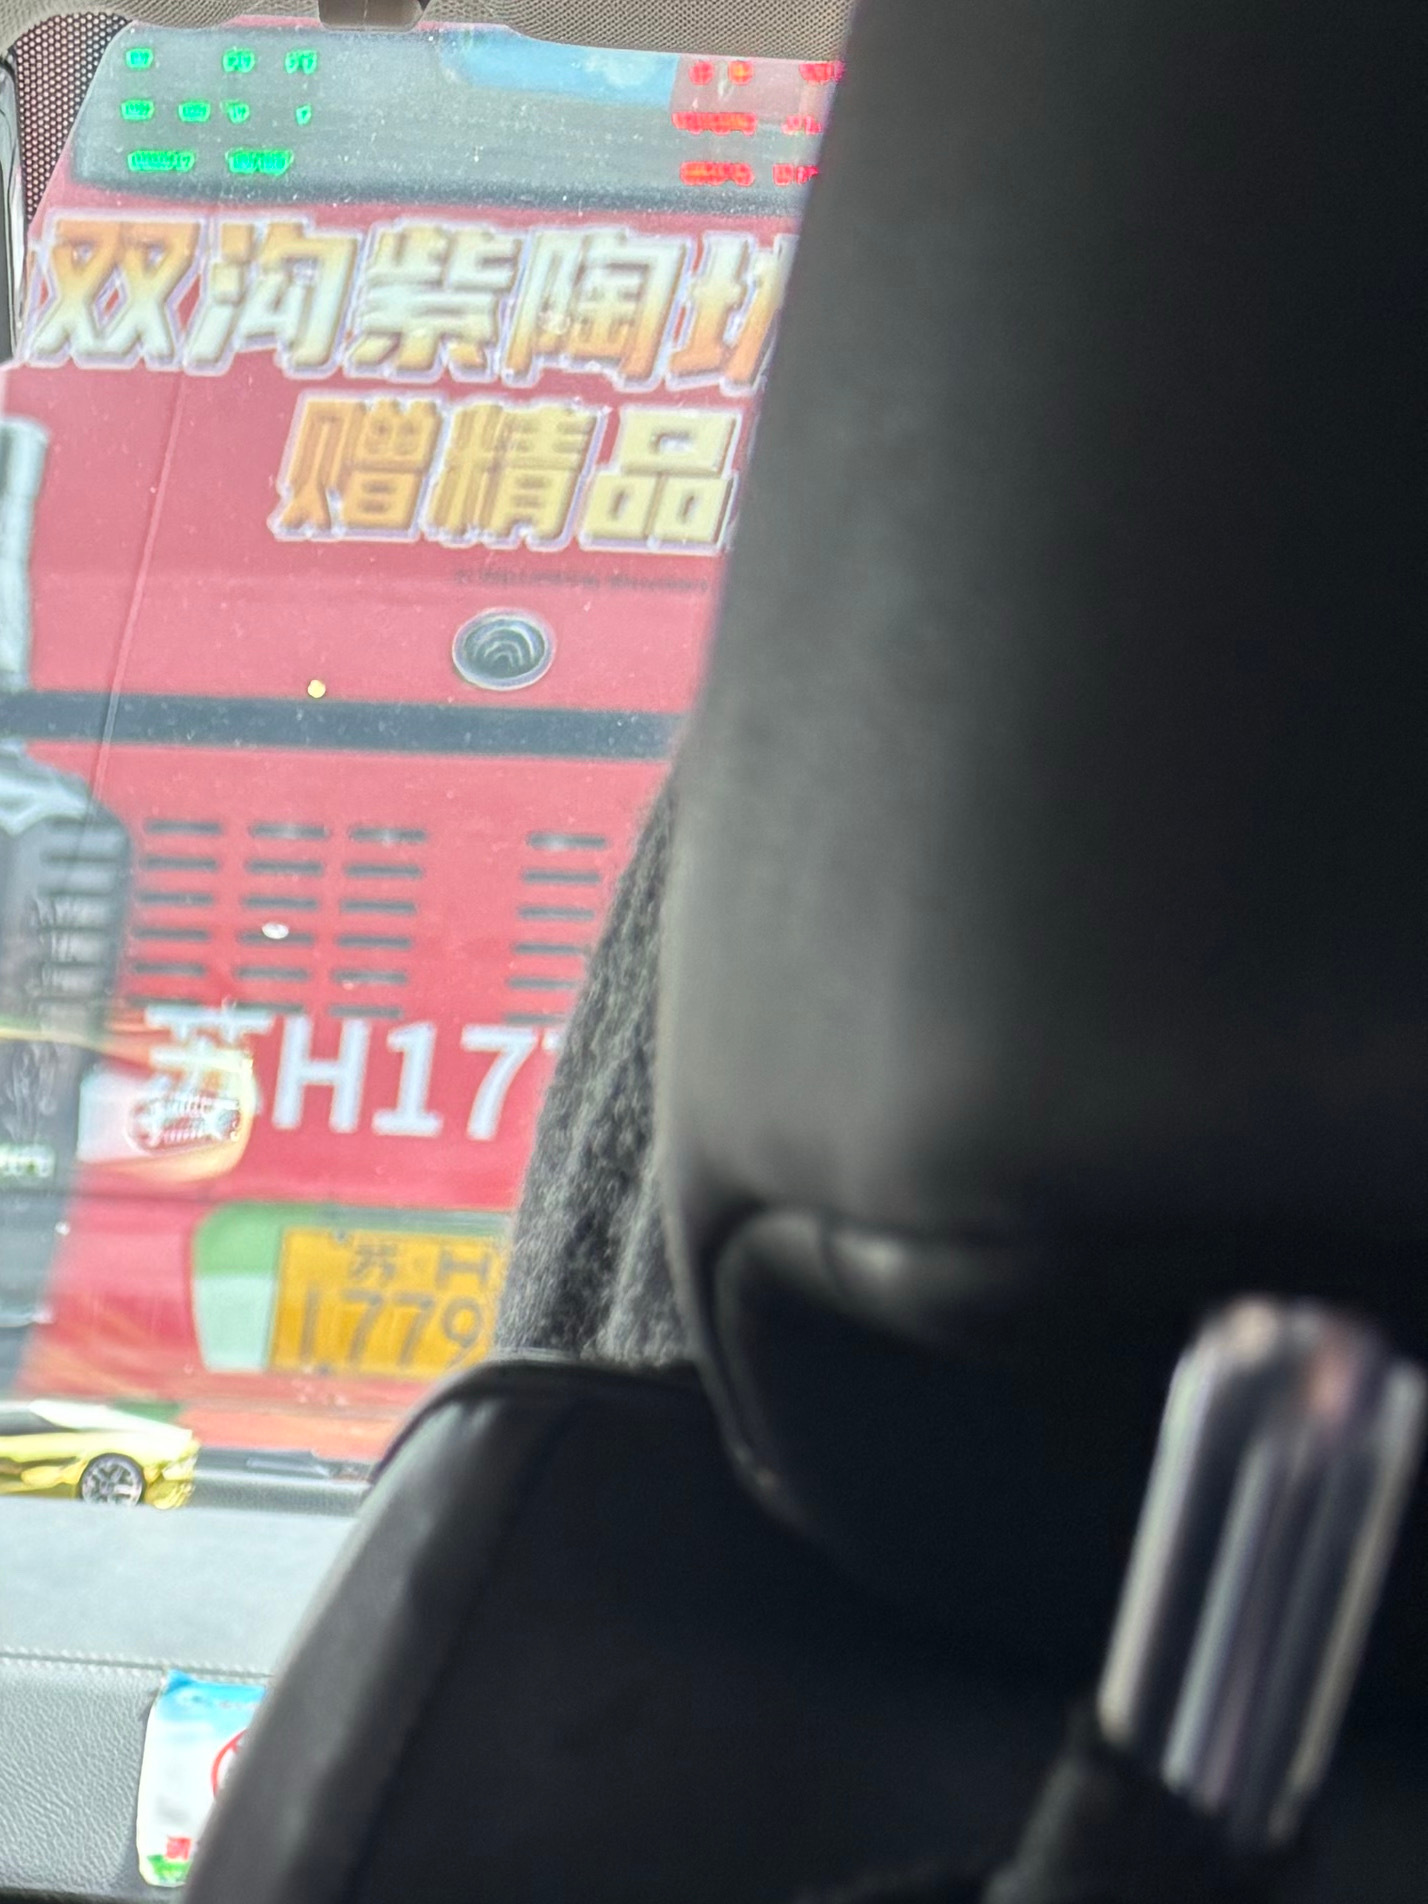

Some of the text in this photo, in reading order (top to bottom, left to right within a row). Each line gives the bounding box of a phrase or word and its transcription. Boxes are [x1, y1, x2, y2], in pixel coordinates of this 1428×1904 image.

[18, 206, 800, 393] 双沟紫陶
[268, 390, 743, 556] 赠精品
[142, 1003, 568, 1146] 苏H17
